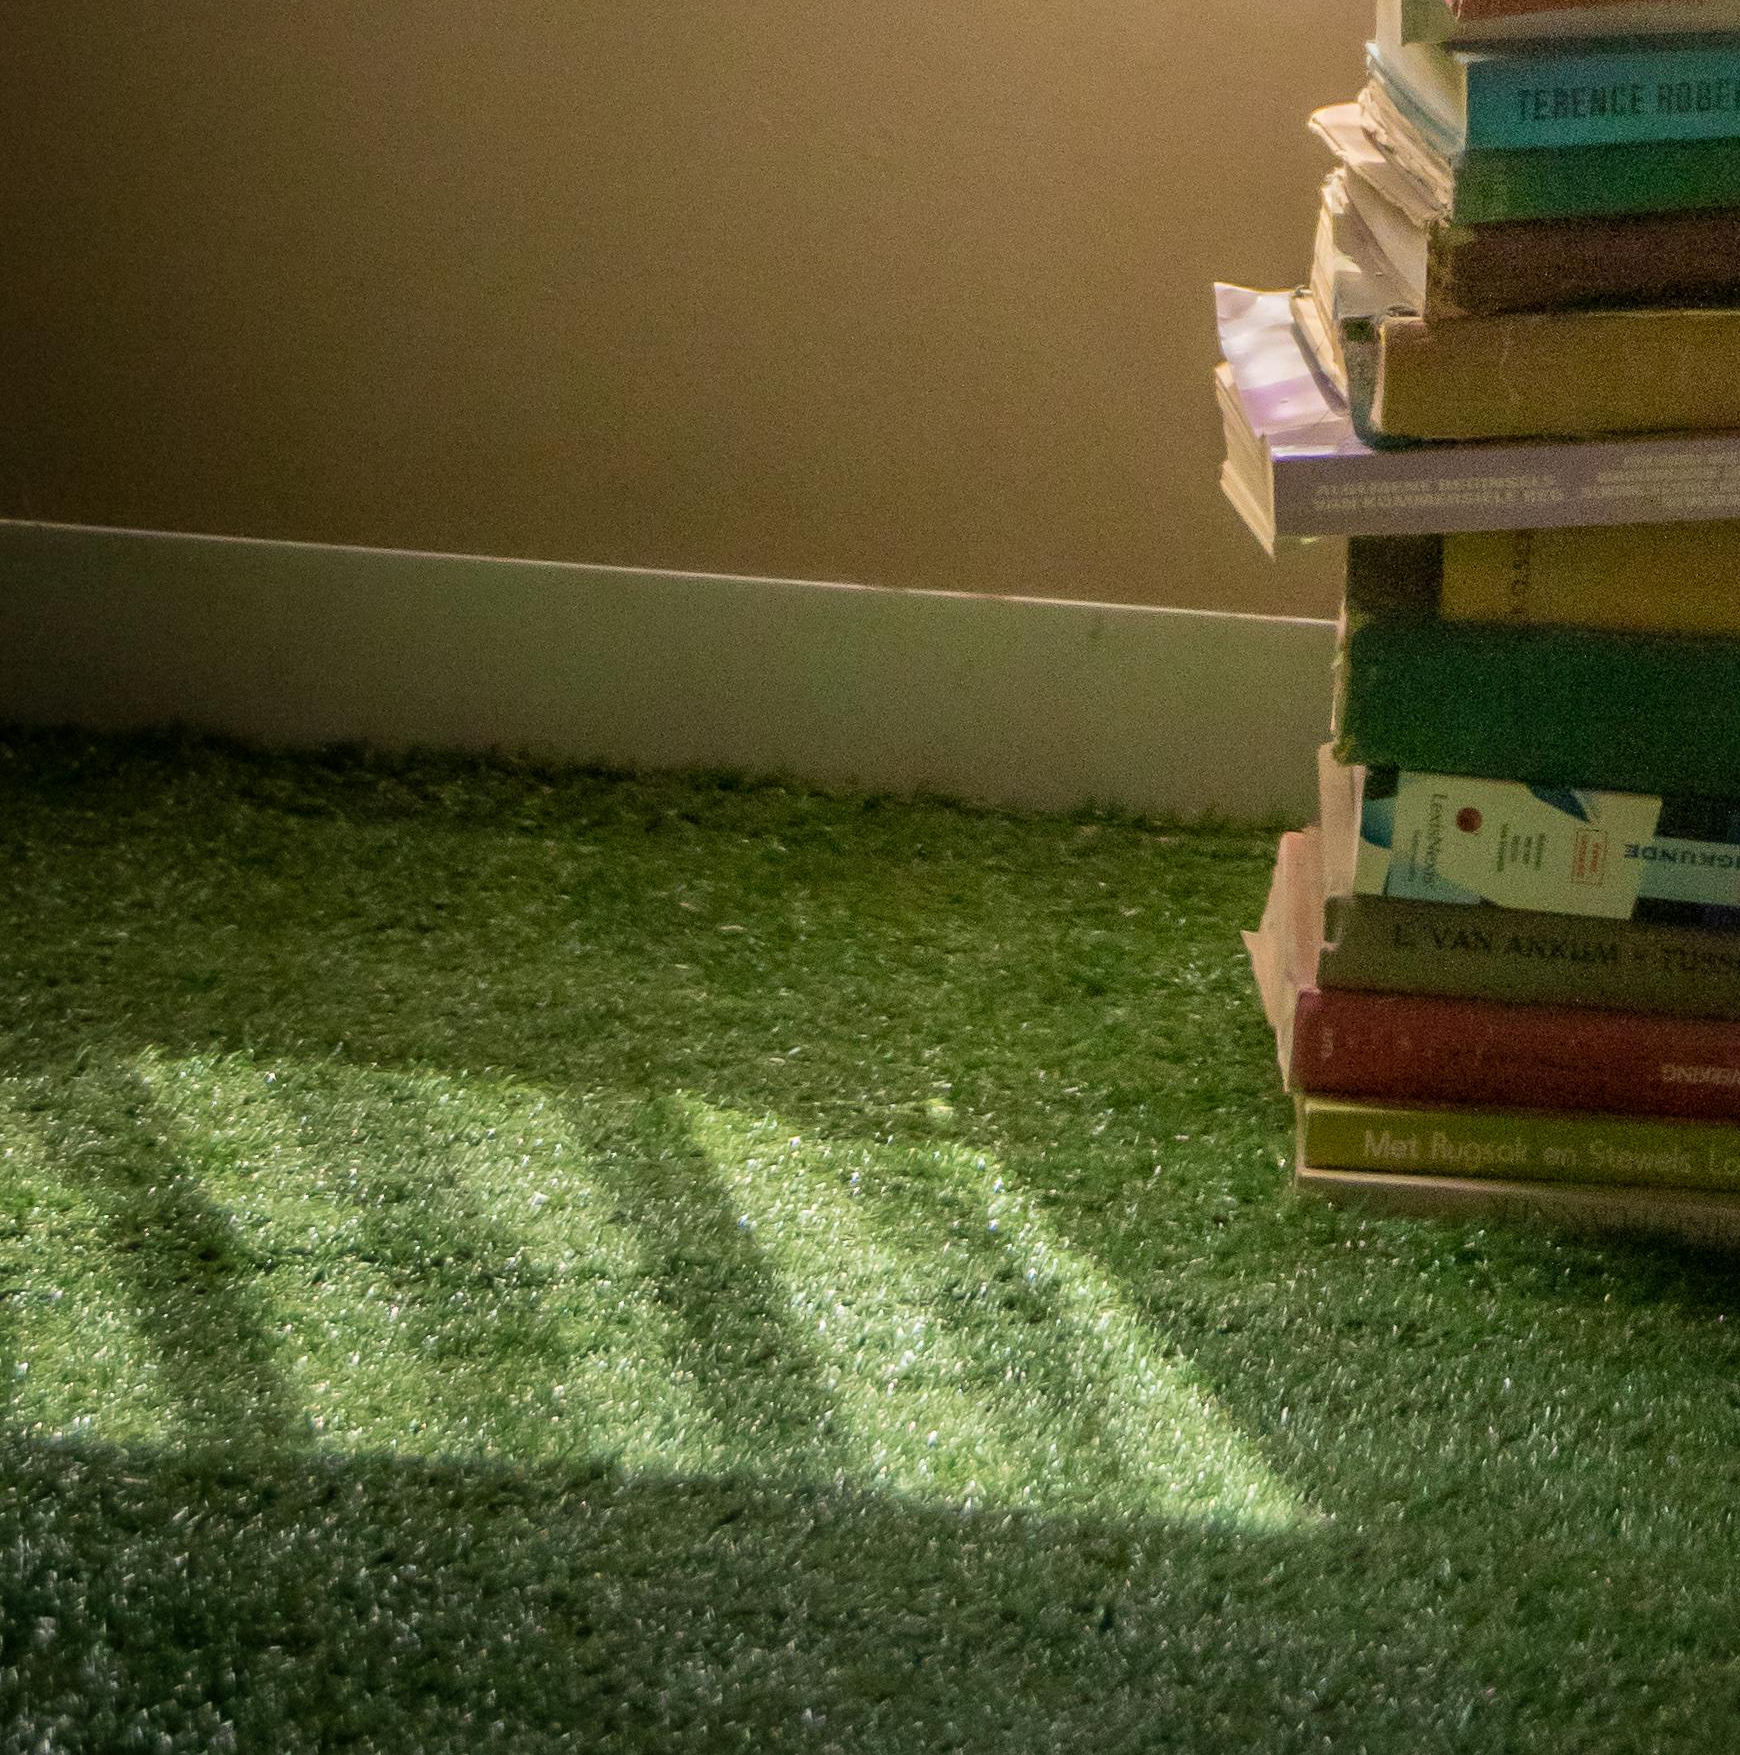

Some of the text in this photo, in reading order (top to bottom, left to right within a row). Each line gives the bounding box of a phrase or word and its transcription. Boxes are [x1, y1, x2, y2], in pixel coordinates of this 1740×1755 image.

[1516, 87, 1645, 124] TERENCE
[1431, 927, 1491, 956] VAN
[1362, 1128, 1421, 1162] Met
[1429, 1131, 1530, 1174] Rugsak
[1542, 1143, 1578, 1169] en
[1587, 1140, 1692, 1176] Stewels
